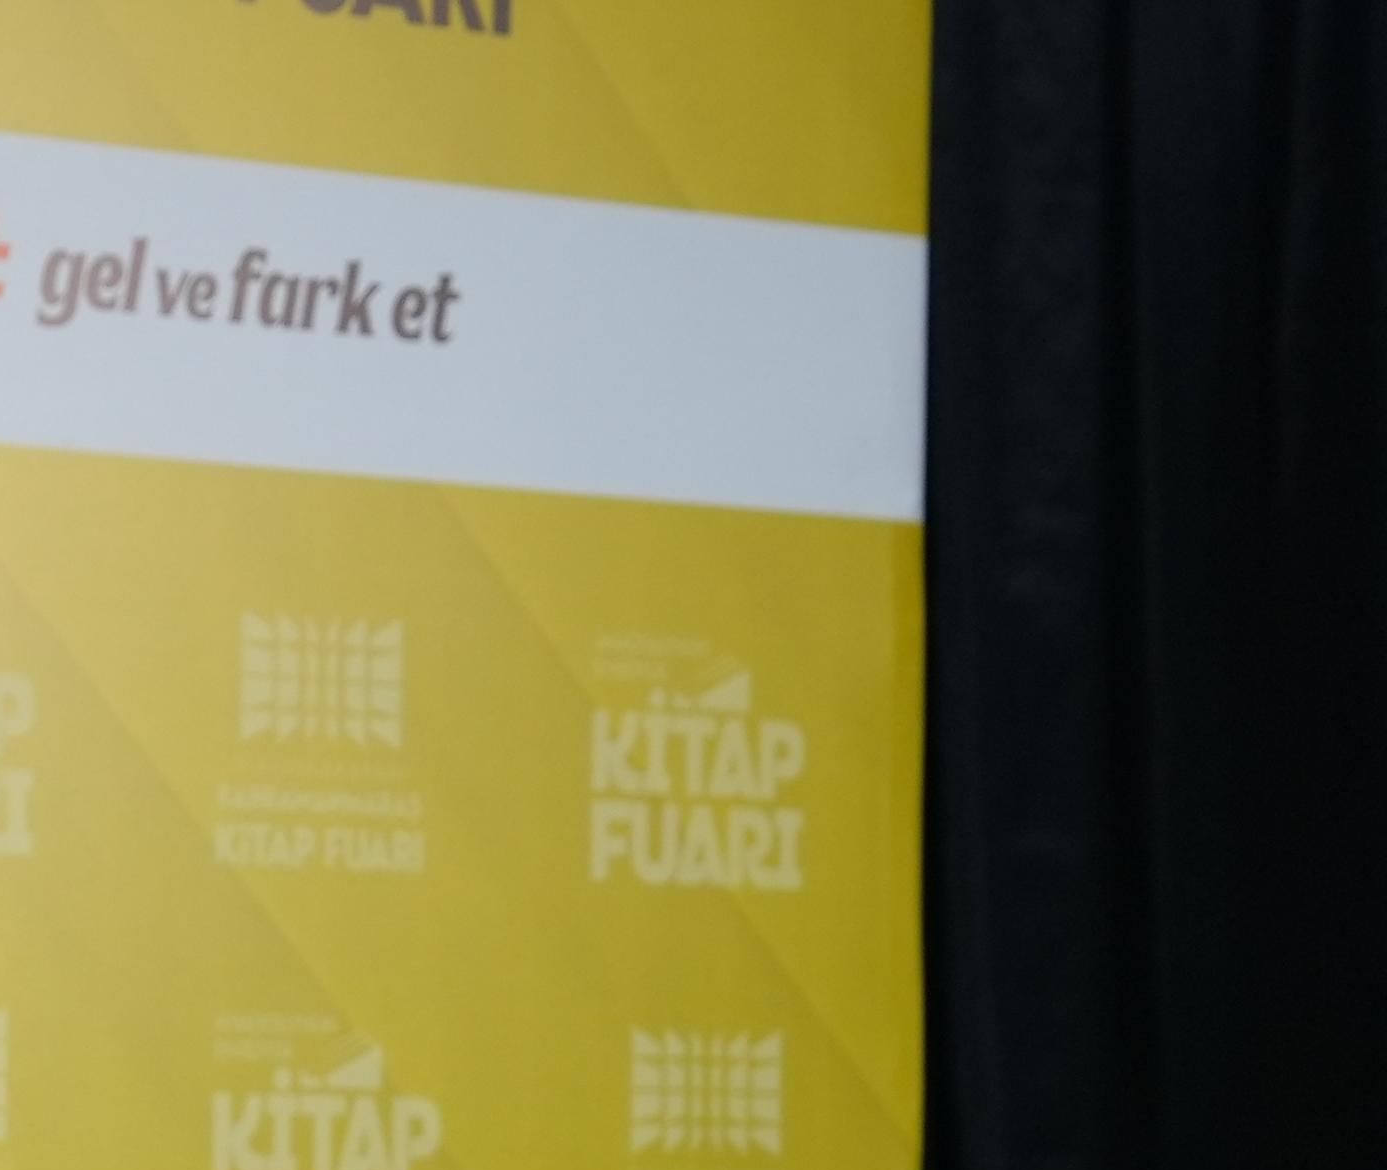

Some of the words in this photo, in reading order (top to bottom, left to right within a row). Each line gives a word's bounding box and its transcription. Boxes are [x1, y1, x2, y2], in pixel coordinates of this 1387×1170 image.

[35, 236, 150, 328] gel
[154, 265, 219, 321] ve
[227, 245, 382, 339] fark
[390, 270, 463, 345] et
[590, 800, 805, 892] FUARI
